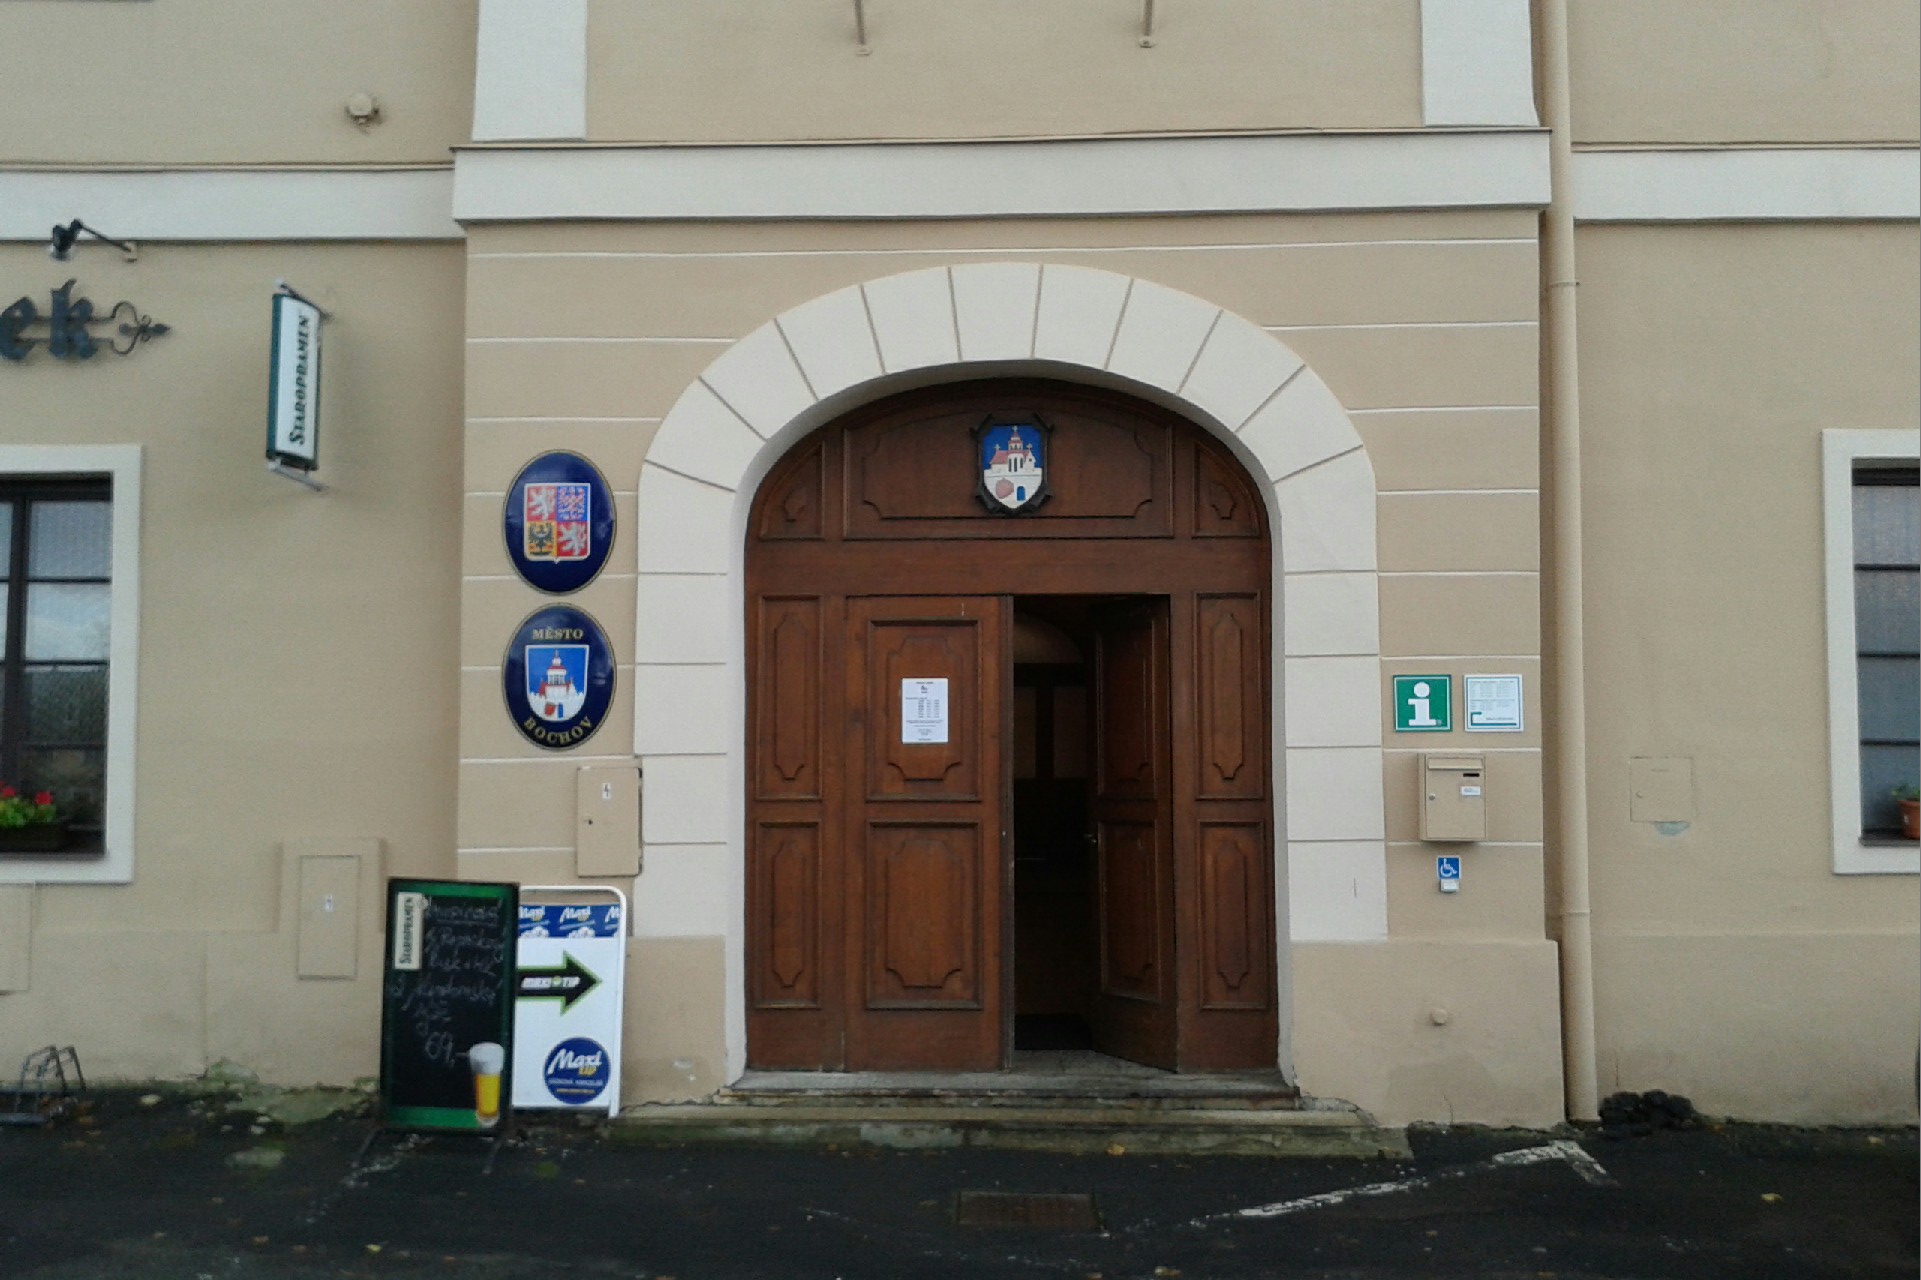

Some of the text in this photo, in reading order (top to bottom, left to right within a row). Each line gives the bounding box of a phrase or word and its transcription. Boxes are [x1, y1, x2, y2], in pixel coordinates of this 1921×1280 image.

[532, 627, 584, 640] MĚSTO
[524, 715, 593, 745] BOCHOV
[547, 1048, 602, 1075] Maxi
